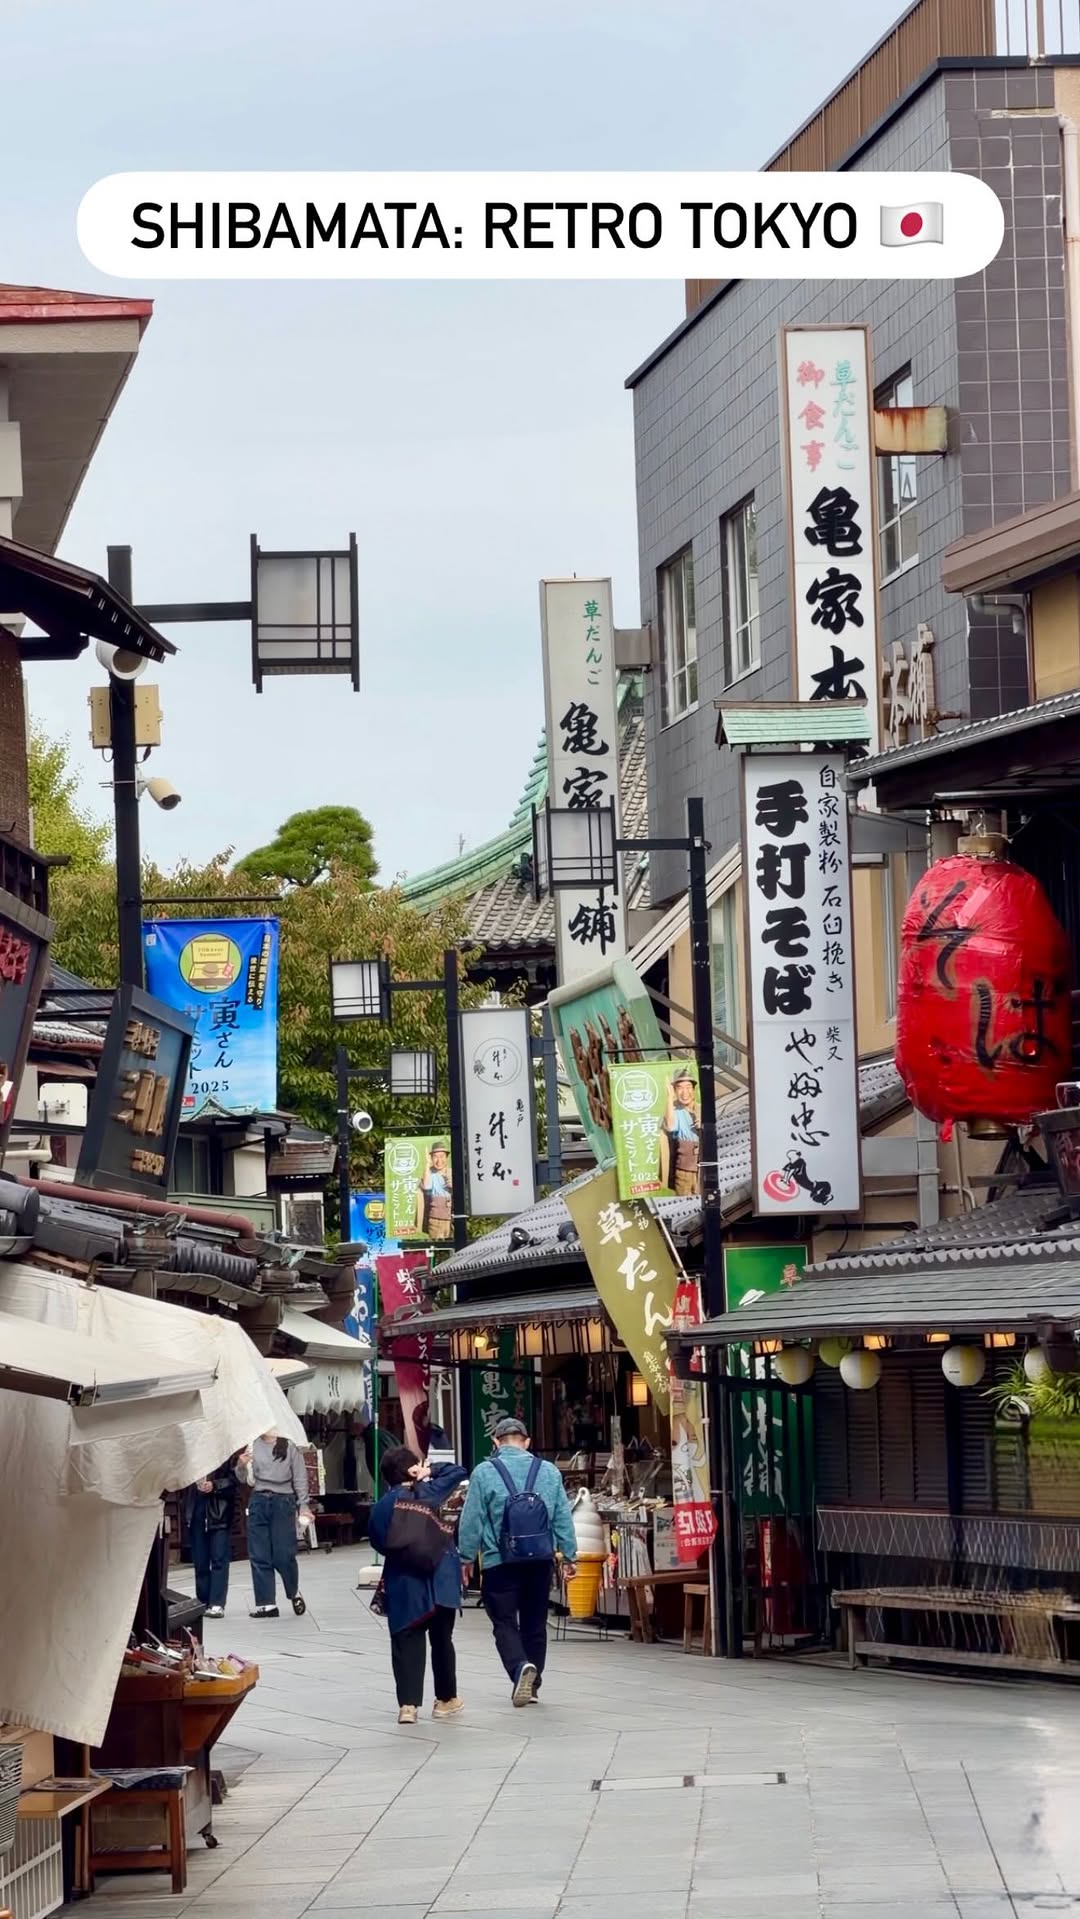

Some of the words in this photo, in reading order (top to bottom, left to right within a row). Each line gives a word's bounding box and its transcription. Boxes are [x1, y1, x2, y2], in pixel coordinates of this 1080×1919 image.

[796, 360, 826, 473] 御食事
[831, 359, 859, 471] 草だんご
[582, 599, 604, 686] 草だんご
[803, 485, 869, 758] 亀家本
[559, 700, 617, 956] 亀家舗
[817, 764, 843, 875] 自家製粉
[755, 779, 816, 1016] 手打そば
[821, 884, 846, 993] 石臼挽き
[209, 996, 241, 1068] 寅さん
[825, 1025, 844, 1061] 柴又
[191, 1080, 230, 1095] 2025
[620, 1120, 640, 1173] サミット
[630, 1172, 659, 1182] 2025
[637, 1113, 661, 1165] 寅さん
[390, 1179, 404, 1220] サミット
[402, 1175, 419, 1216] 寅さん
[597, 1202, 673, 1372] 草だん
